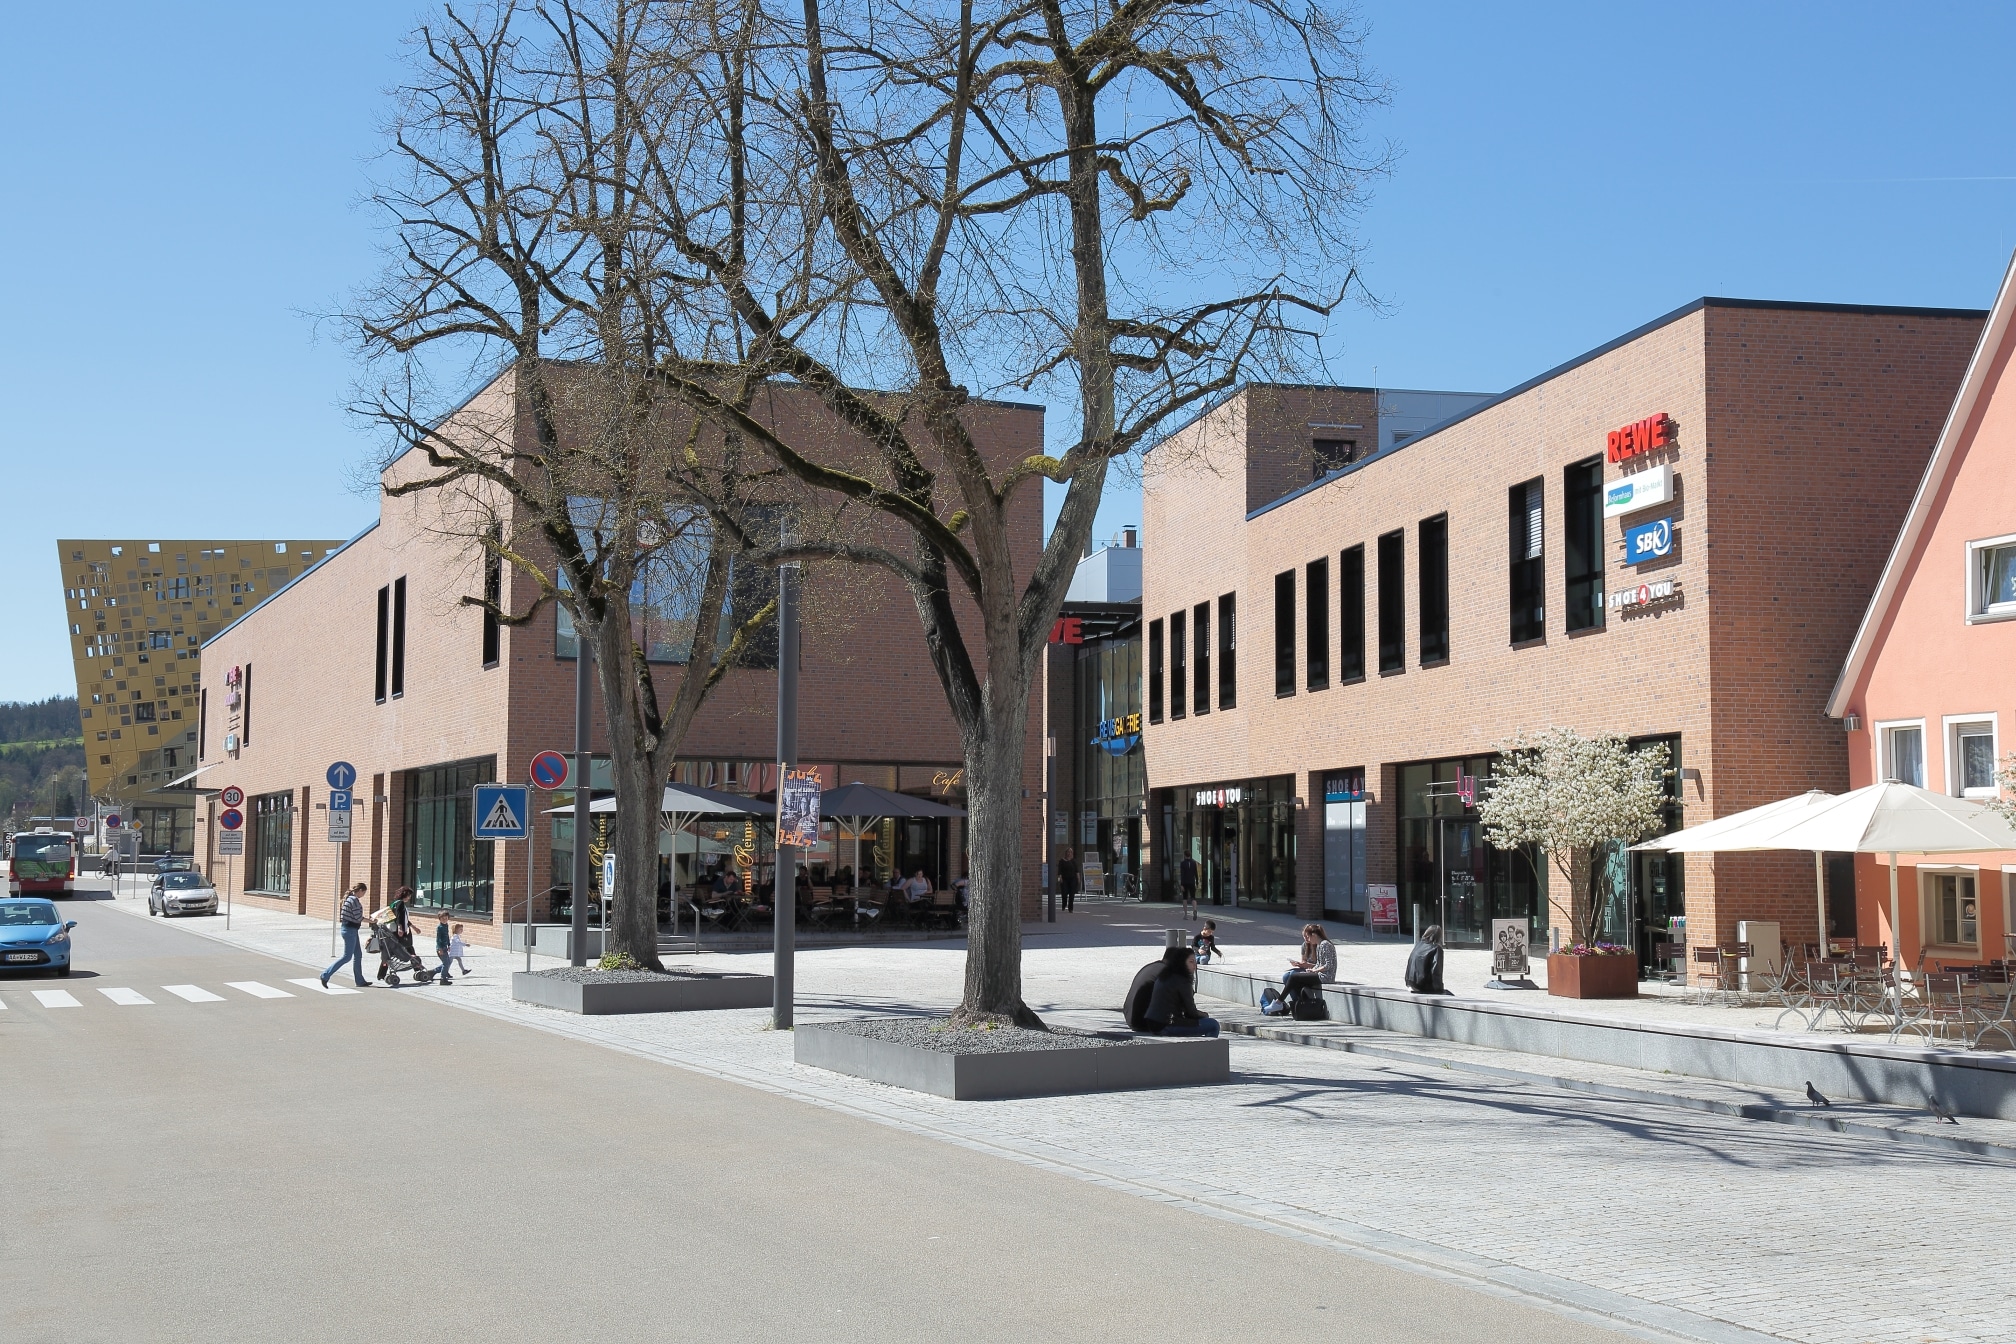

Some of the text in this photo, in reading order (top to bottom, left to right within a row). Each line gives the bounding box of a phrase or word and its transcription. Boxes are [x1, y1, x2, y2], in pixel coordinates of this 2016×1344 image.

[1607, 413, 1666, 463] REWE
[1636, 528, 1663, 554] SBK
[932, 768, 964, 795] Café
[226, 792, 240, 802] 30
[334, 793, 347, 809] P
